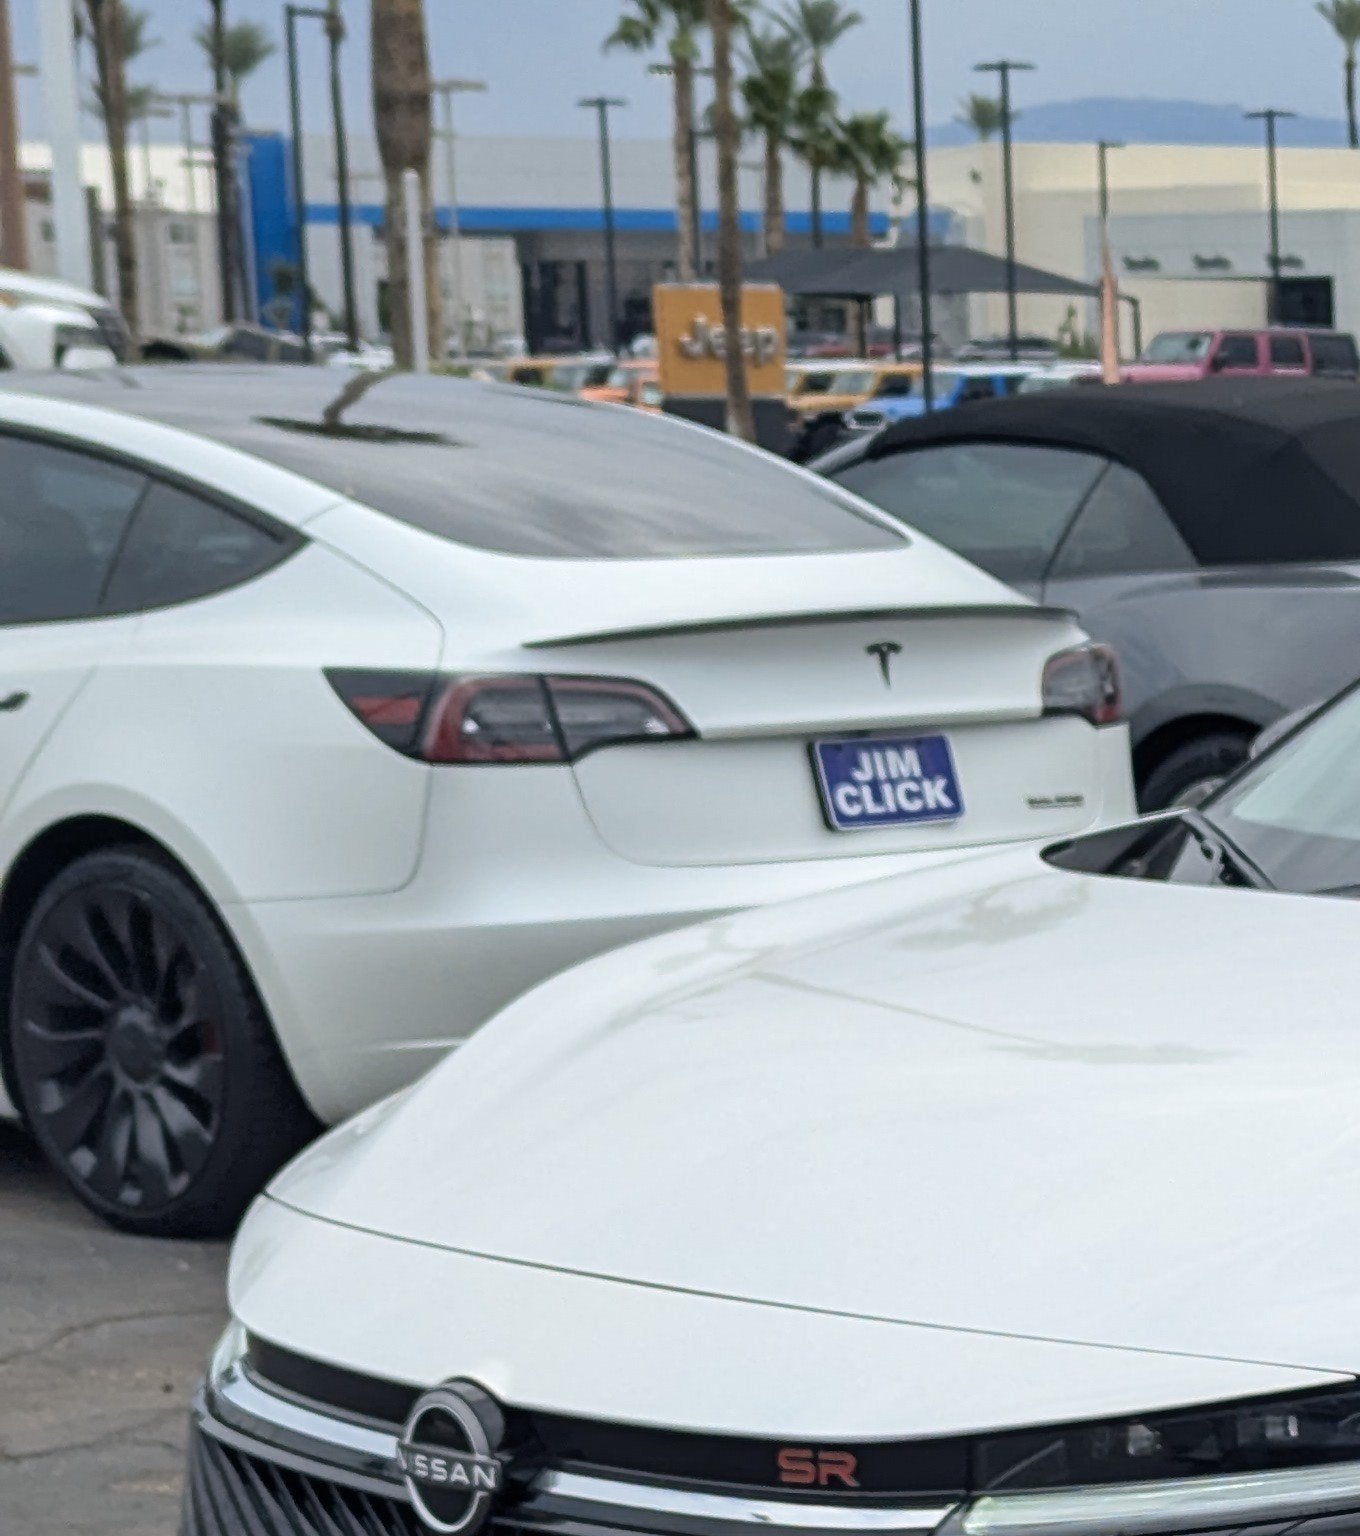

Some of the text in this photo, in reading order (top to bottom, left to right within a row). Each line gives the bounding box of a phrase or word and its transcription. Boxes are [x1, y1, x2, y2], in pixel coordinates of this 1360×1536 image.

[679, 313, 779, 364] Jeep
[851, 746, 922, 781] JIM
[834, 774, 954, 817] CLICK
[777, 1447, 860, 1488] SR
